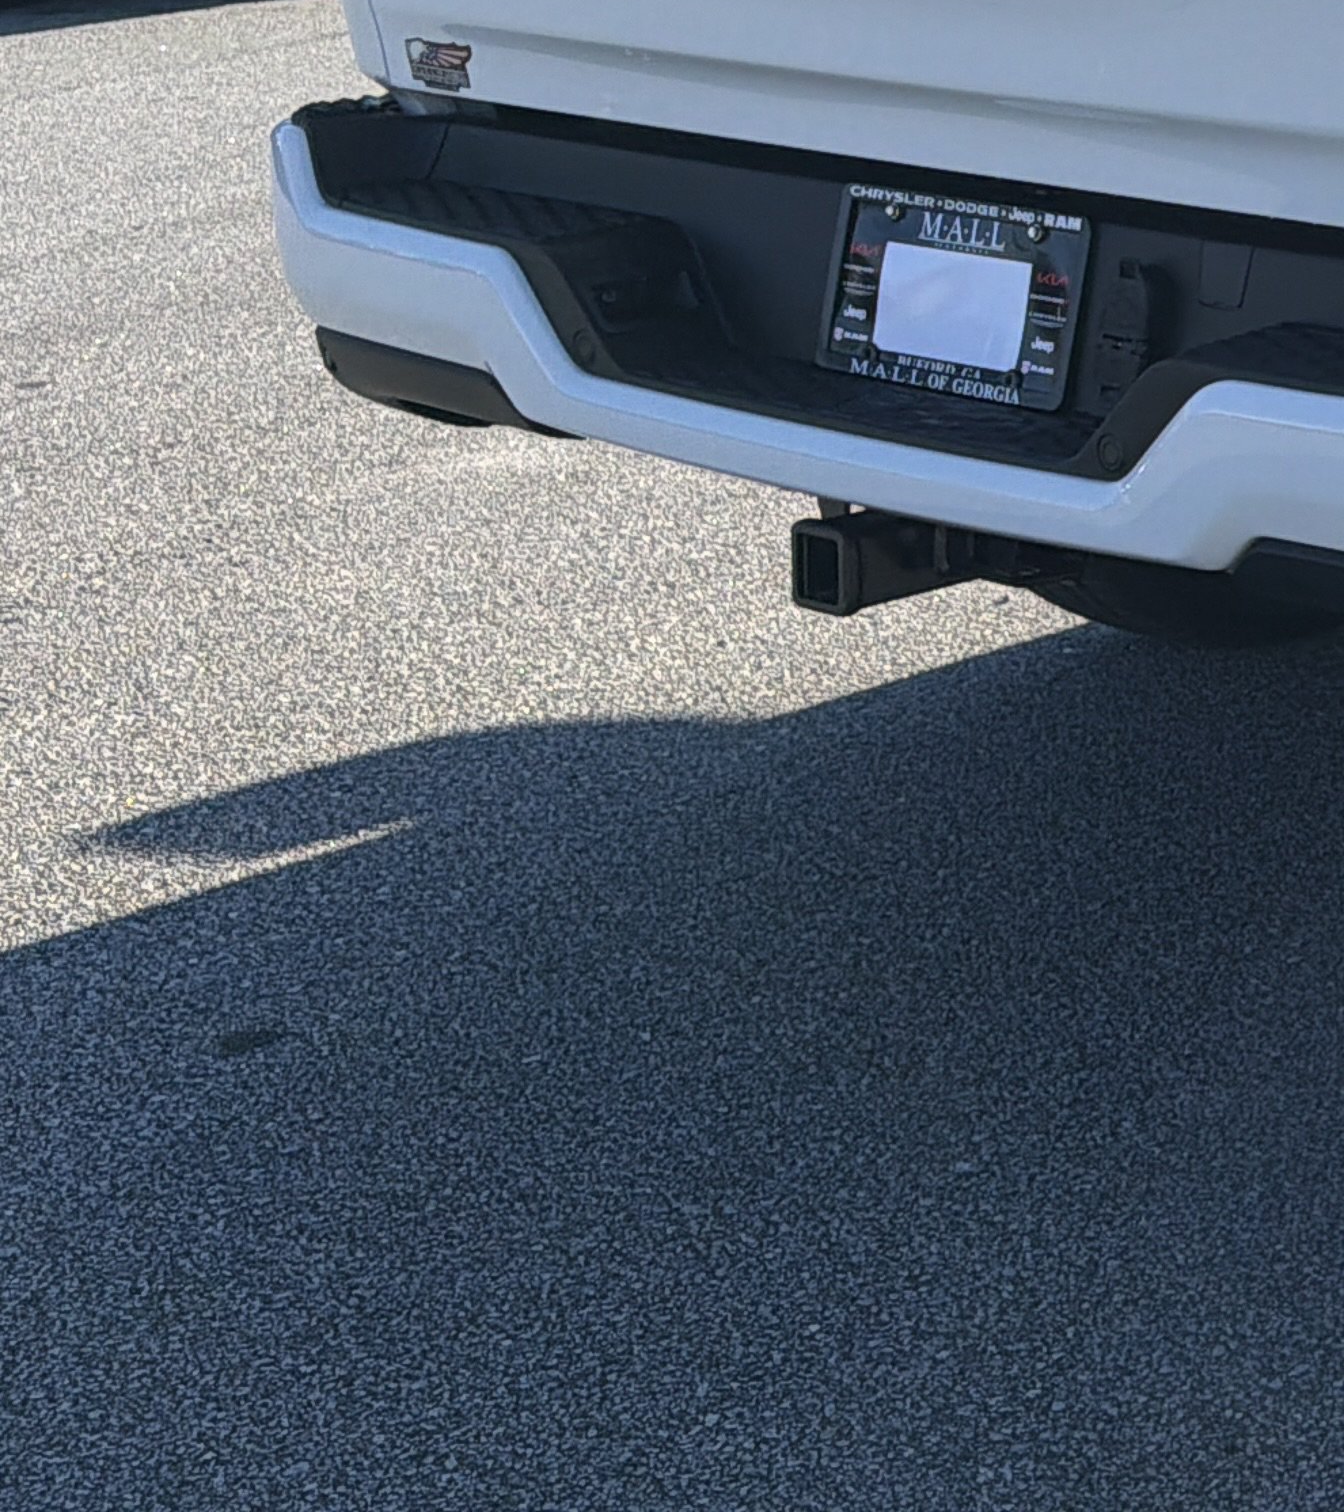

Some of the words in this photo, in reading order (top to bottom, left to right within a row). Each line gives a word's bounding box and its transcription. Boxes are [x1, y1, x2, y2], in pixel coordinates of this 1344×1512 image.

[849, 185, 935, 208] CHRYSLER
[944, 198, 999, 218] DODGE
[1008, 206, 1035, 225] Jeep
[1043, 214, 1082, 231] RAM
[1030, 335, 1054, 354] Jeep
[927, 373, 949, 391] OF
[952, 377, 1020, 405] GEORGIA
